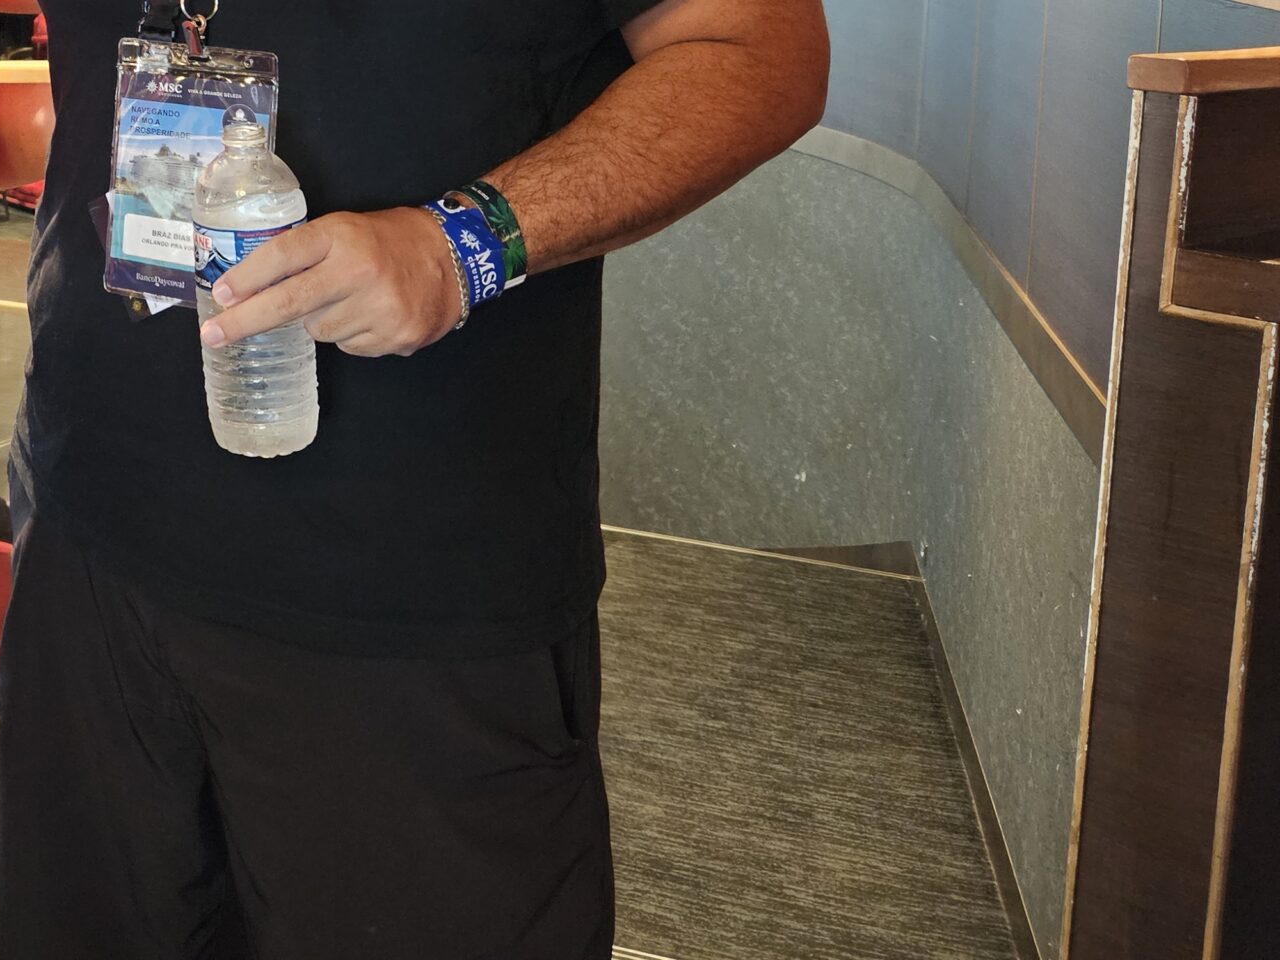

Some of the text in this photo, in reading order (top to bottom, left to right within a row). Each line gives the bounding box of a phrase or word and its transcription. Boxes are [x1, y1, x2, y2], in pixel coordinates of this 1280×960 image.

[158, 82, 182, 94] MSC
[132, 106, 180, 118] NAVEGANDO
[173, 233, 191, 242] DIAS
[474, 248, 497, 298] MSC
